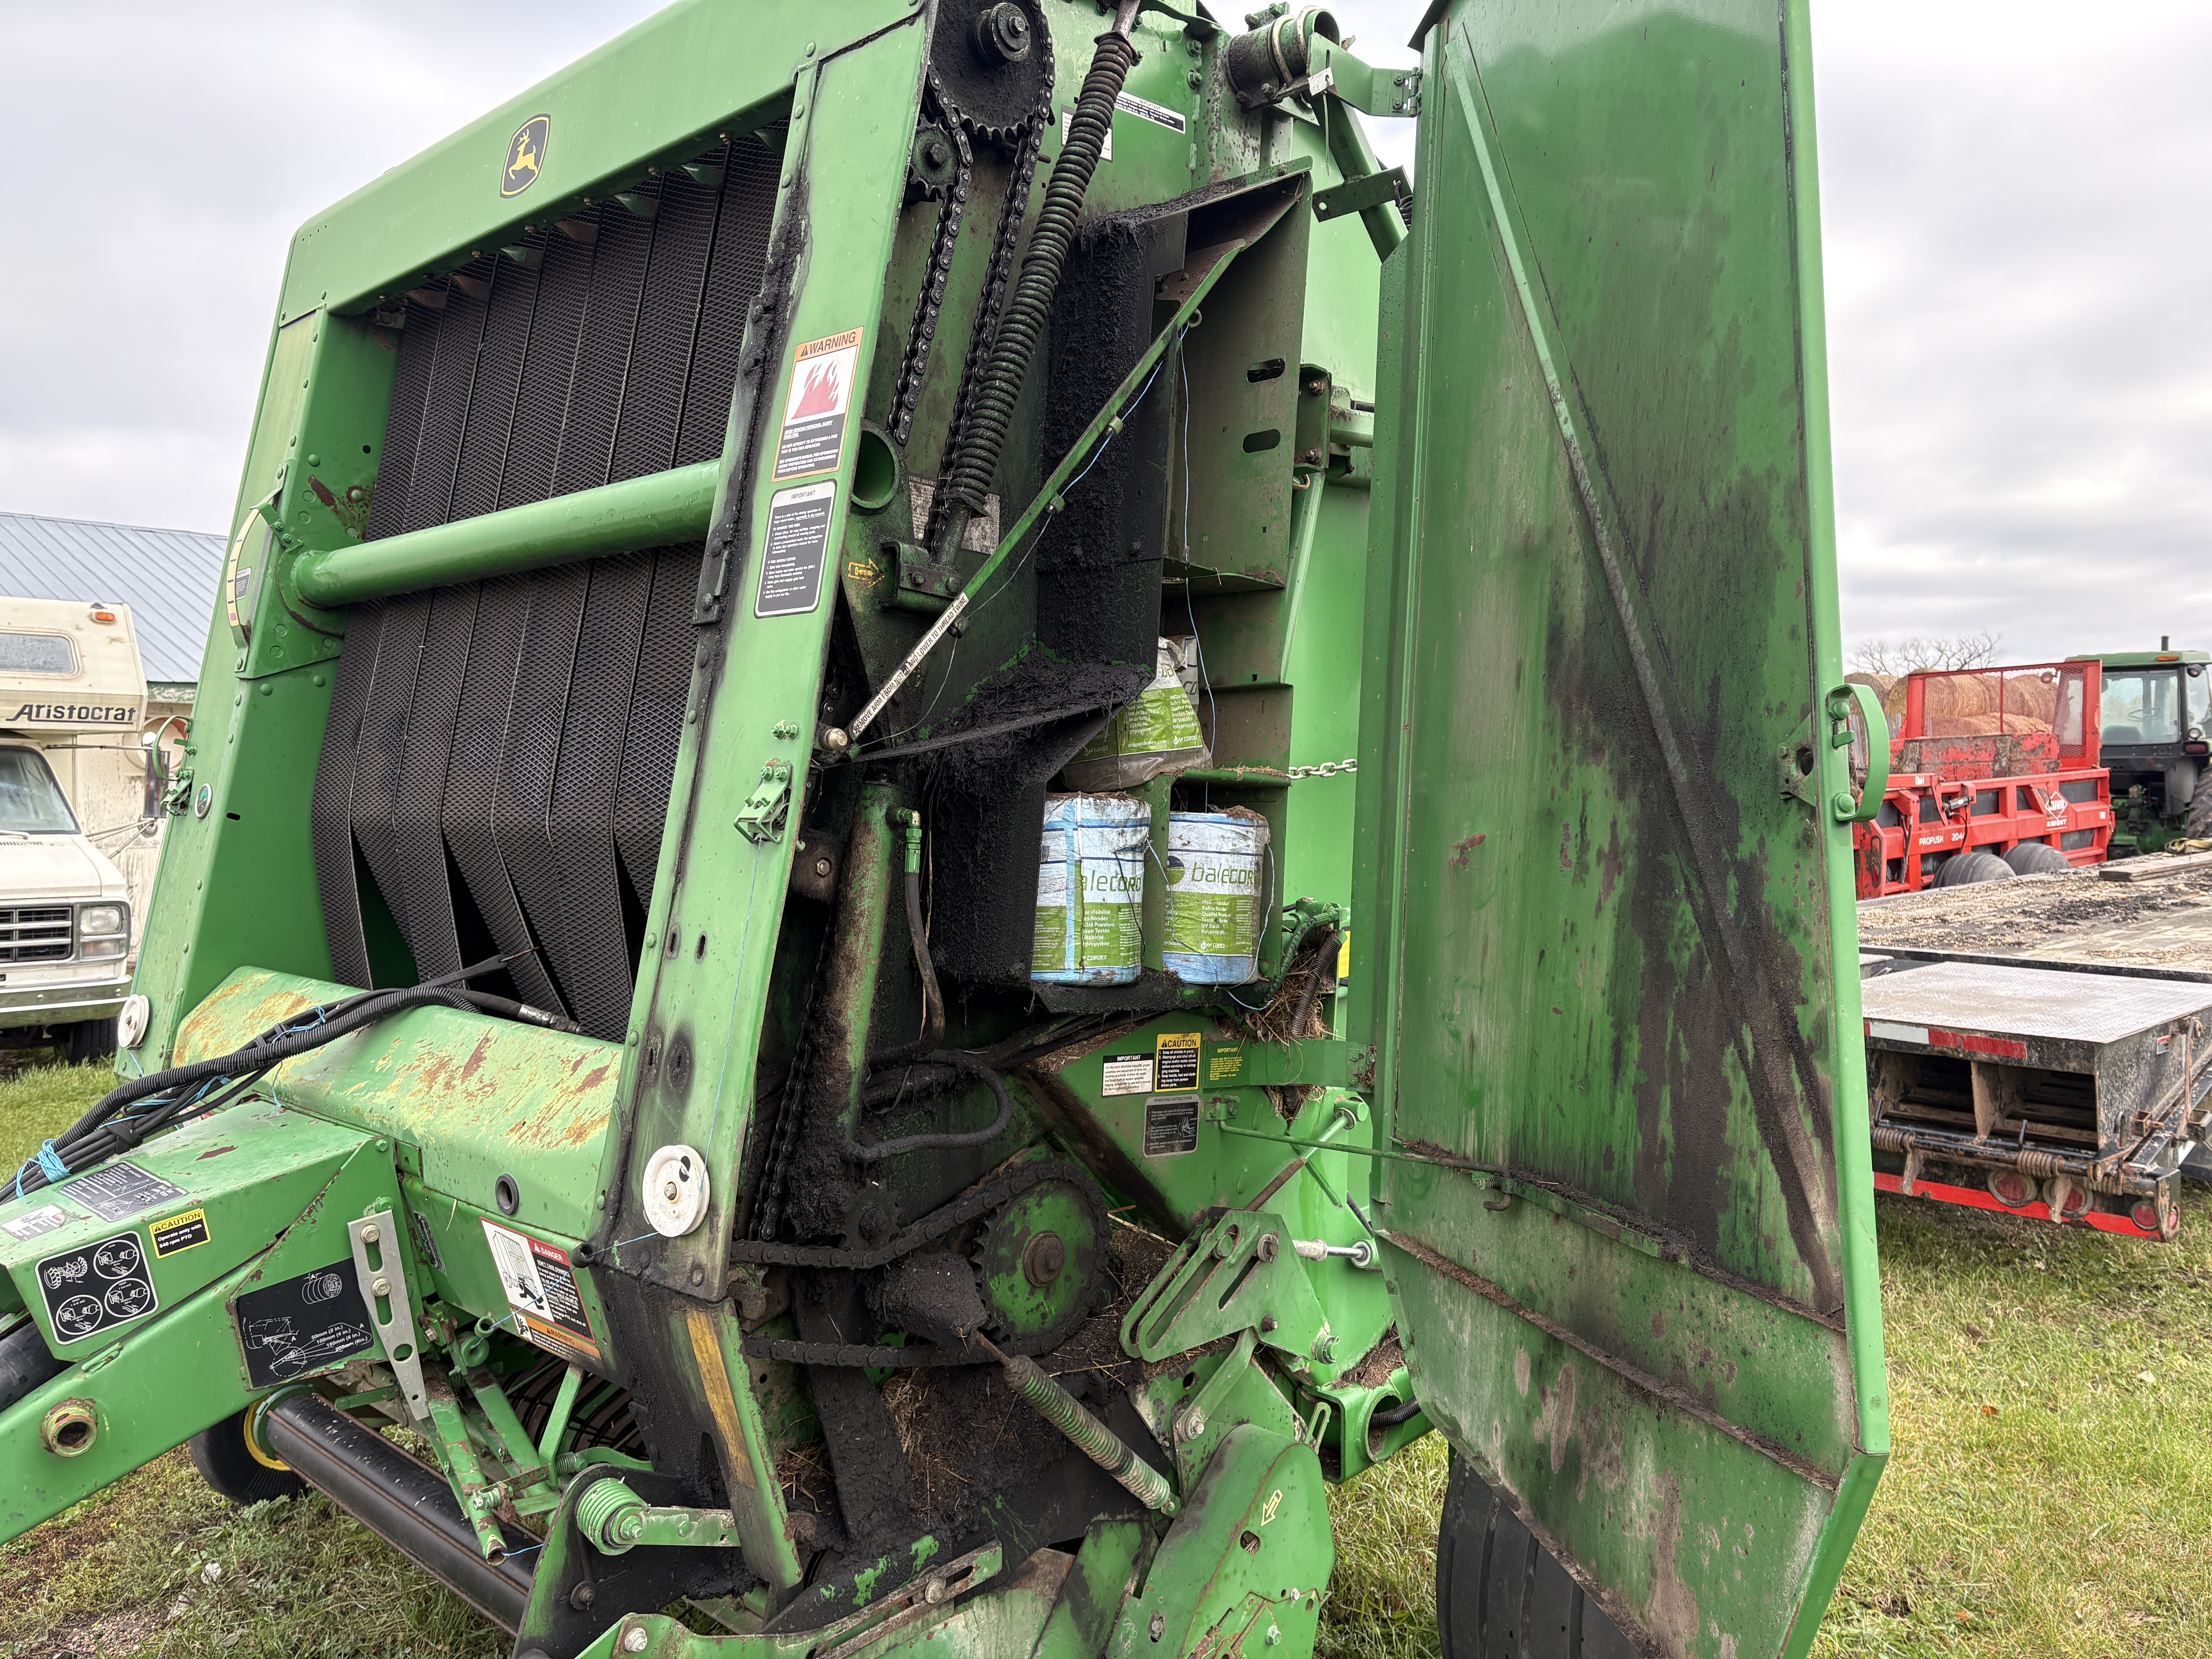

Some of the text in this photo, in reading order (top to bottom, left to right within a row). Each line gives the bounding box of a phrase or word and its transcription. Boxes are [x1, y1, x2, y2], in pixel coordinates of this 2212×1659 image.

[810, 331, 856, 354] WARNING
[792, 490, 816, 499] IMPORTANT
[854, 709, 873, 733] REMOVE
[871, 697, 883, 712] ARM
[881, 682, 896, 700] FROM
[908, 655, 918, 668] AND
[917, 637, 933, 656] LOWER
[931, 630, 939, 639] TO
[937, 611, 954, 632] THREAD
[953, 596, 967, 613] TWINE
[5, 704, 136, 724] Aristocrat
[2047, 819, 2067, 827] KNIGHT
[1919, 835, 1944, 846] PROPUSH
[1168, 1039, 1196, 1048] CAUTION
[161, 1212, 201, 1229] CAUTION
[158, 1232, 178, 1242] Operate
[540, 1247, 563, 1262] DANGER
[311, 1331, 327, 1340] 50mm
[316, 1334, 335, 1344] 100mm
[550, 1329, 575, 1345] WARNING
[326, 1338, 345, 1347] 150mm
